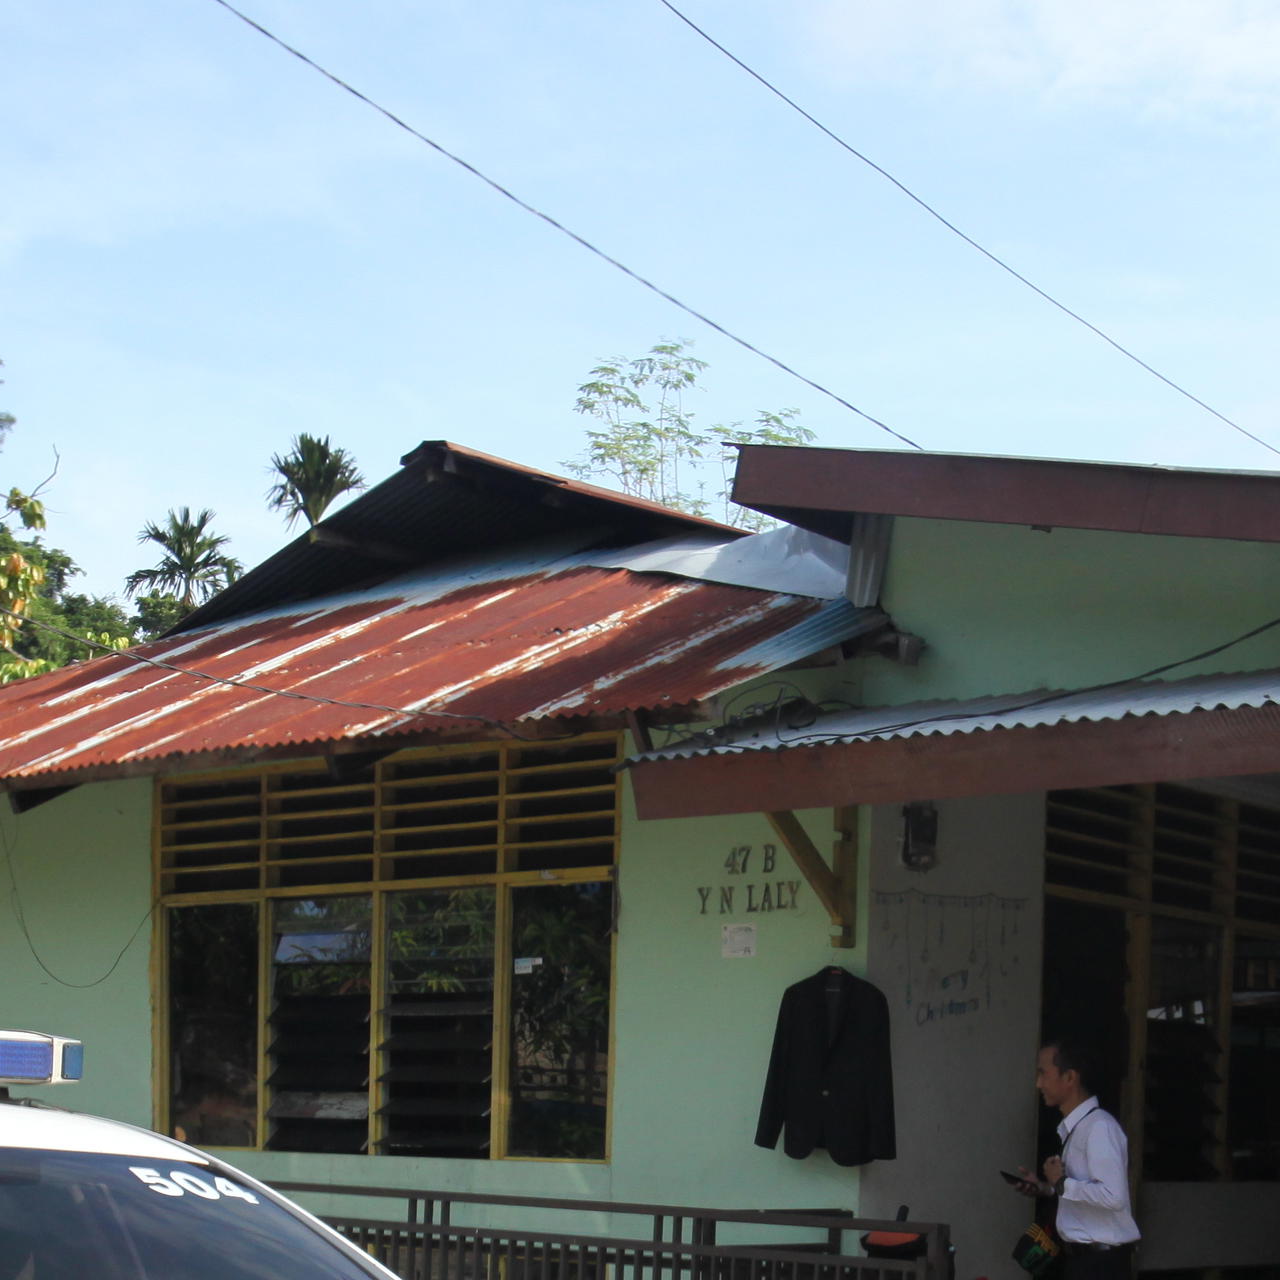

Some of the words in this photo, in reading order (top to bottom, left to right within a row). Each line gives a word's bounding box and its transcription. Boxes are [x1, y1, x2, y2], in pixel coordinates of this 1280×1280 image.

[762, 844, 777, 873] B
[697, 886, 712, 915] Y
[719, 885, 735, 914] N
[128, 1166, 260, 1205] 504
